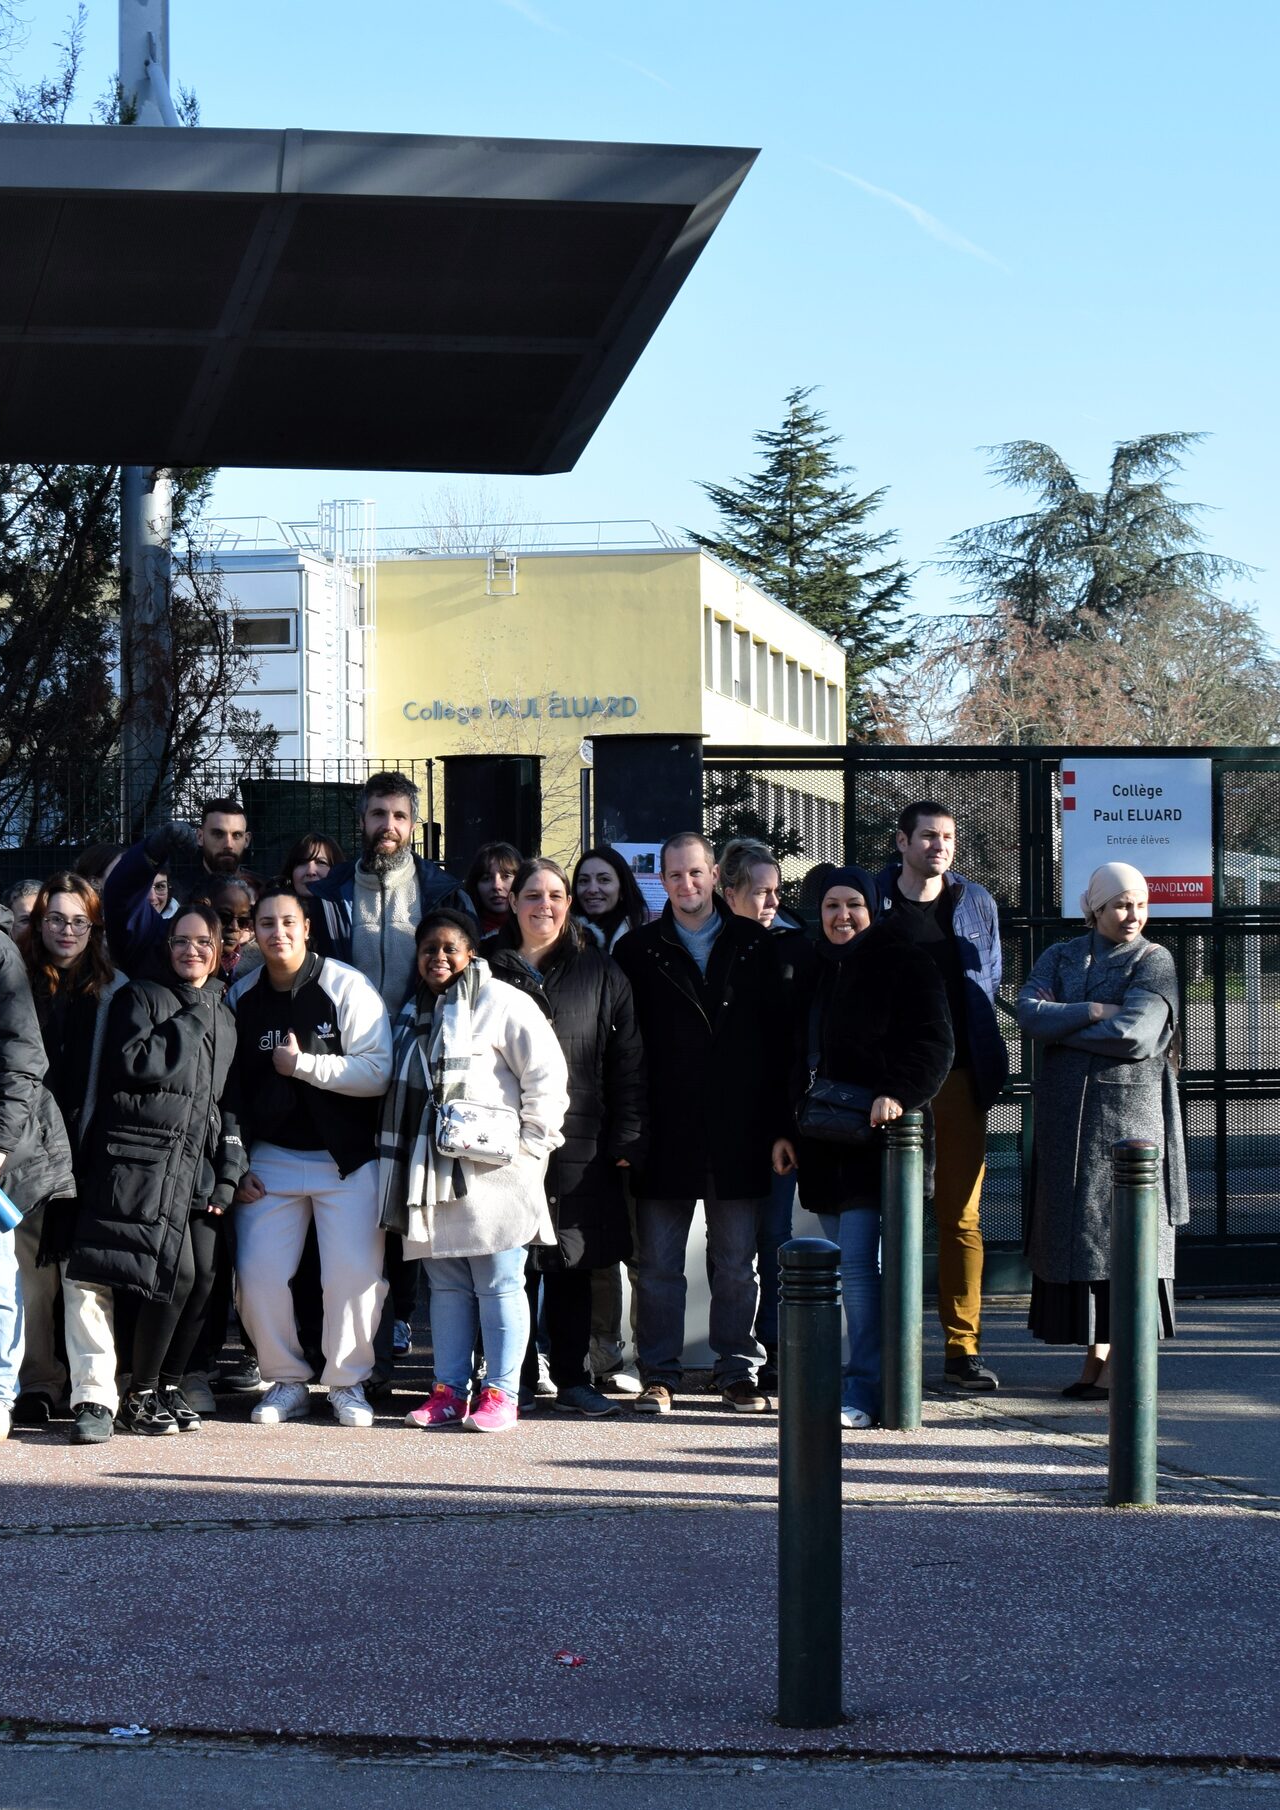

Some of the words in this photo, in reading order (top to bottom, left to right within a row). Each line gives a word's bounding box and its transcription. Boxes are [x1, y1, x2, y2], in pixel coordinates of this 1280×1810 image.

[403, 700, 482, 725] Collège
[489, 697, 542, 719] PAUL
[549, 690, 639, 719] ÉLUARD
[1112, 784, 1163, 799] Collège
[1093, 809, 1122, 822] Paul
[1127, 808, 1182, 821] ELUARD
[1106, 835, 1138, 845] Entrée
[1140, 835, 1170, 845] élèves
